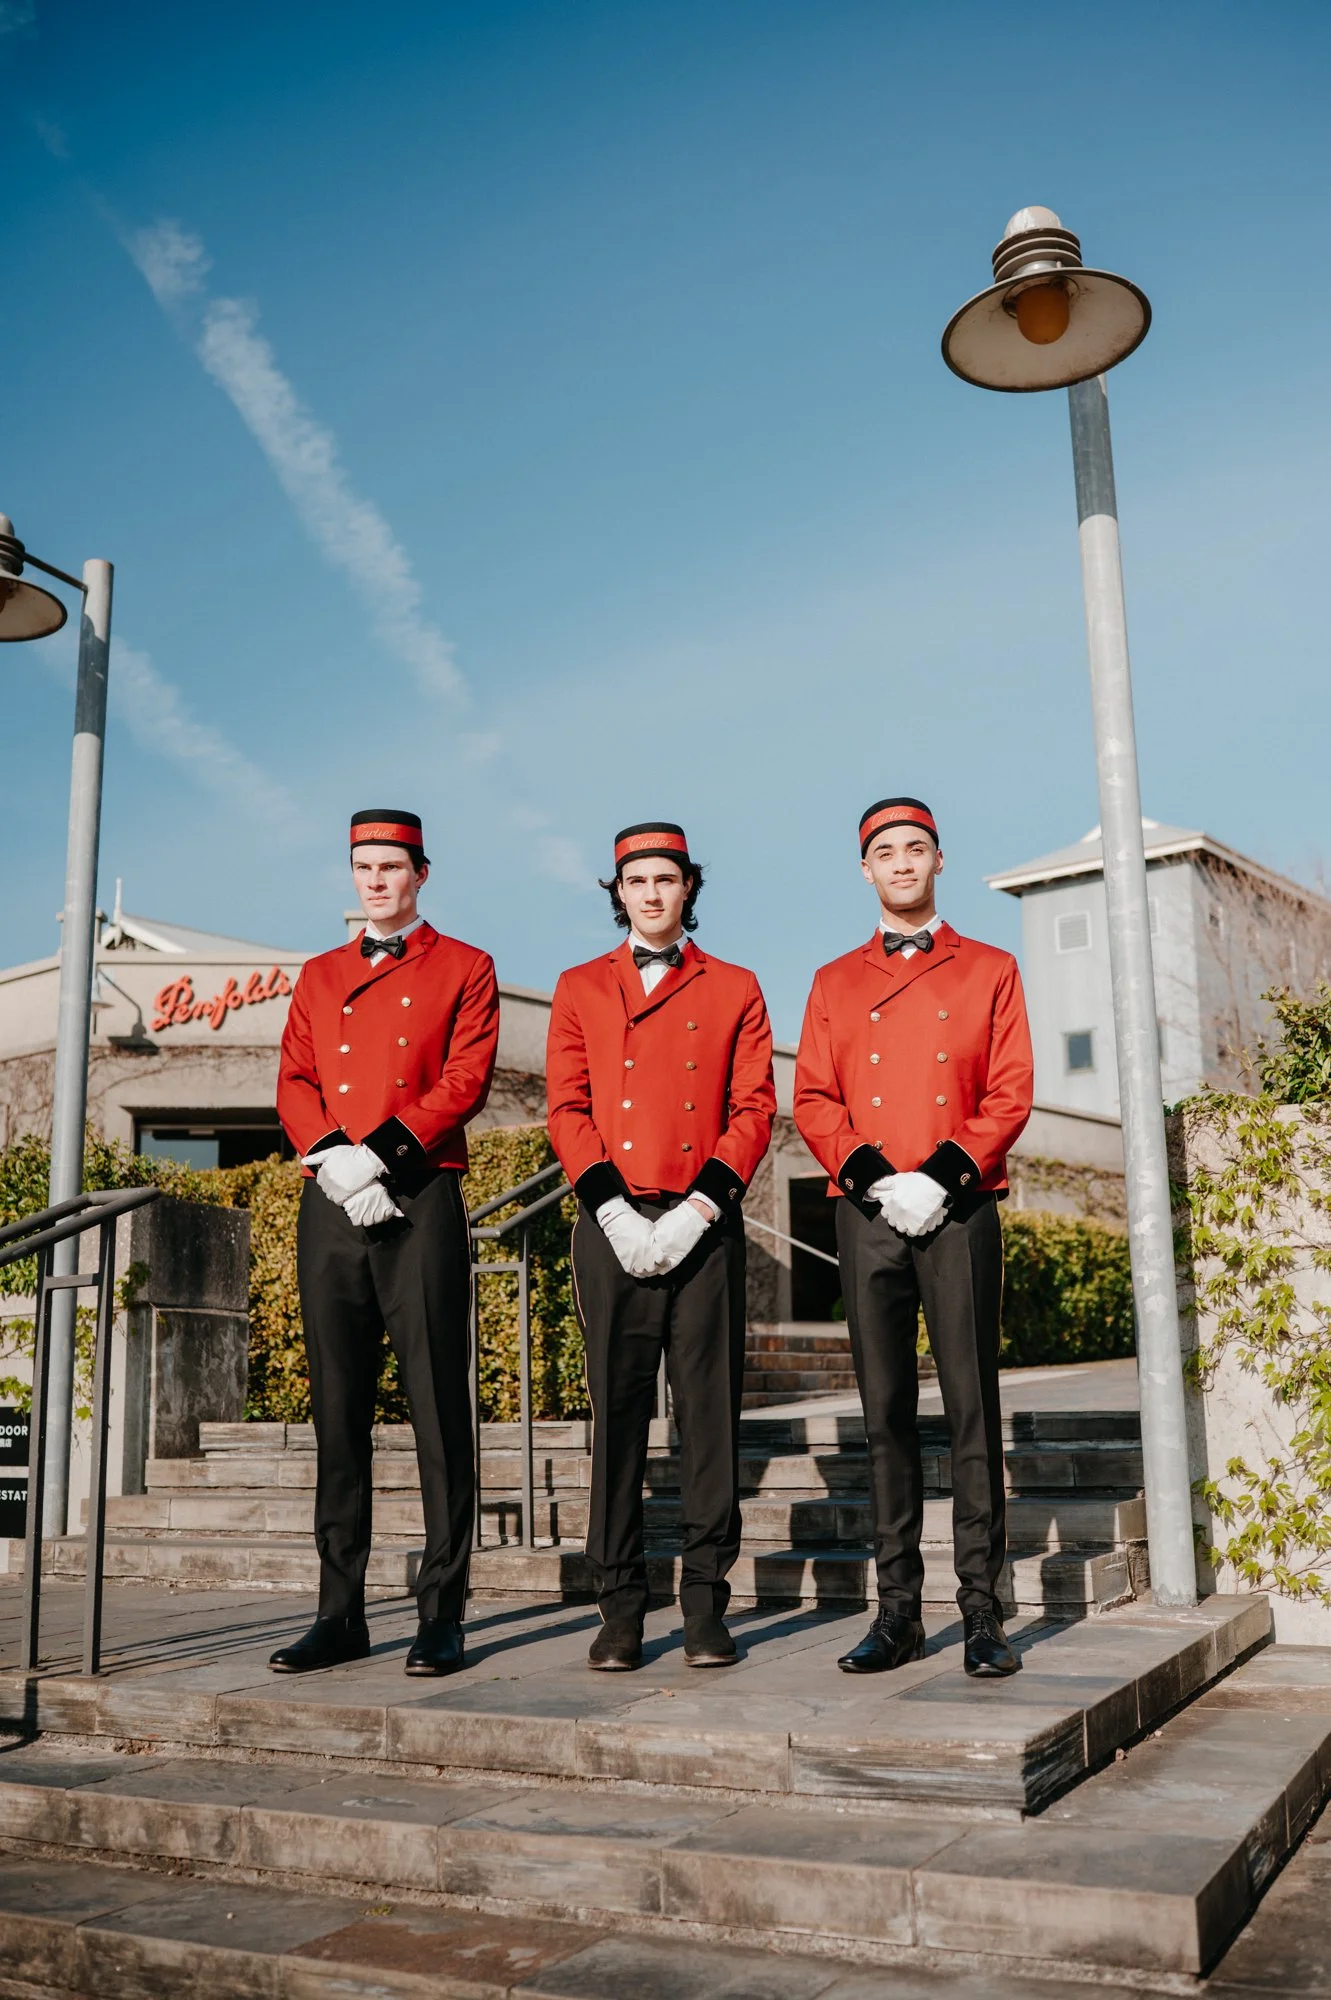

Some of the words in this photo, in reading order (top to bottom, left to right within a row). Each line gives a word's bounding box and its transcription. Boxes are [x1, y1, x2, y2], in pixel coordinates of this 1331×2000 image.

[355, 825, 397, 839] Cartier
[628, 836, 672, 851] Cartier
[151, 964, 292, 1031] Penfolds
[0, 1490, 27, 1501] STAT
